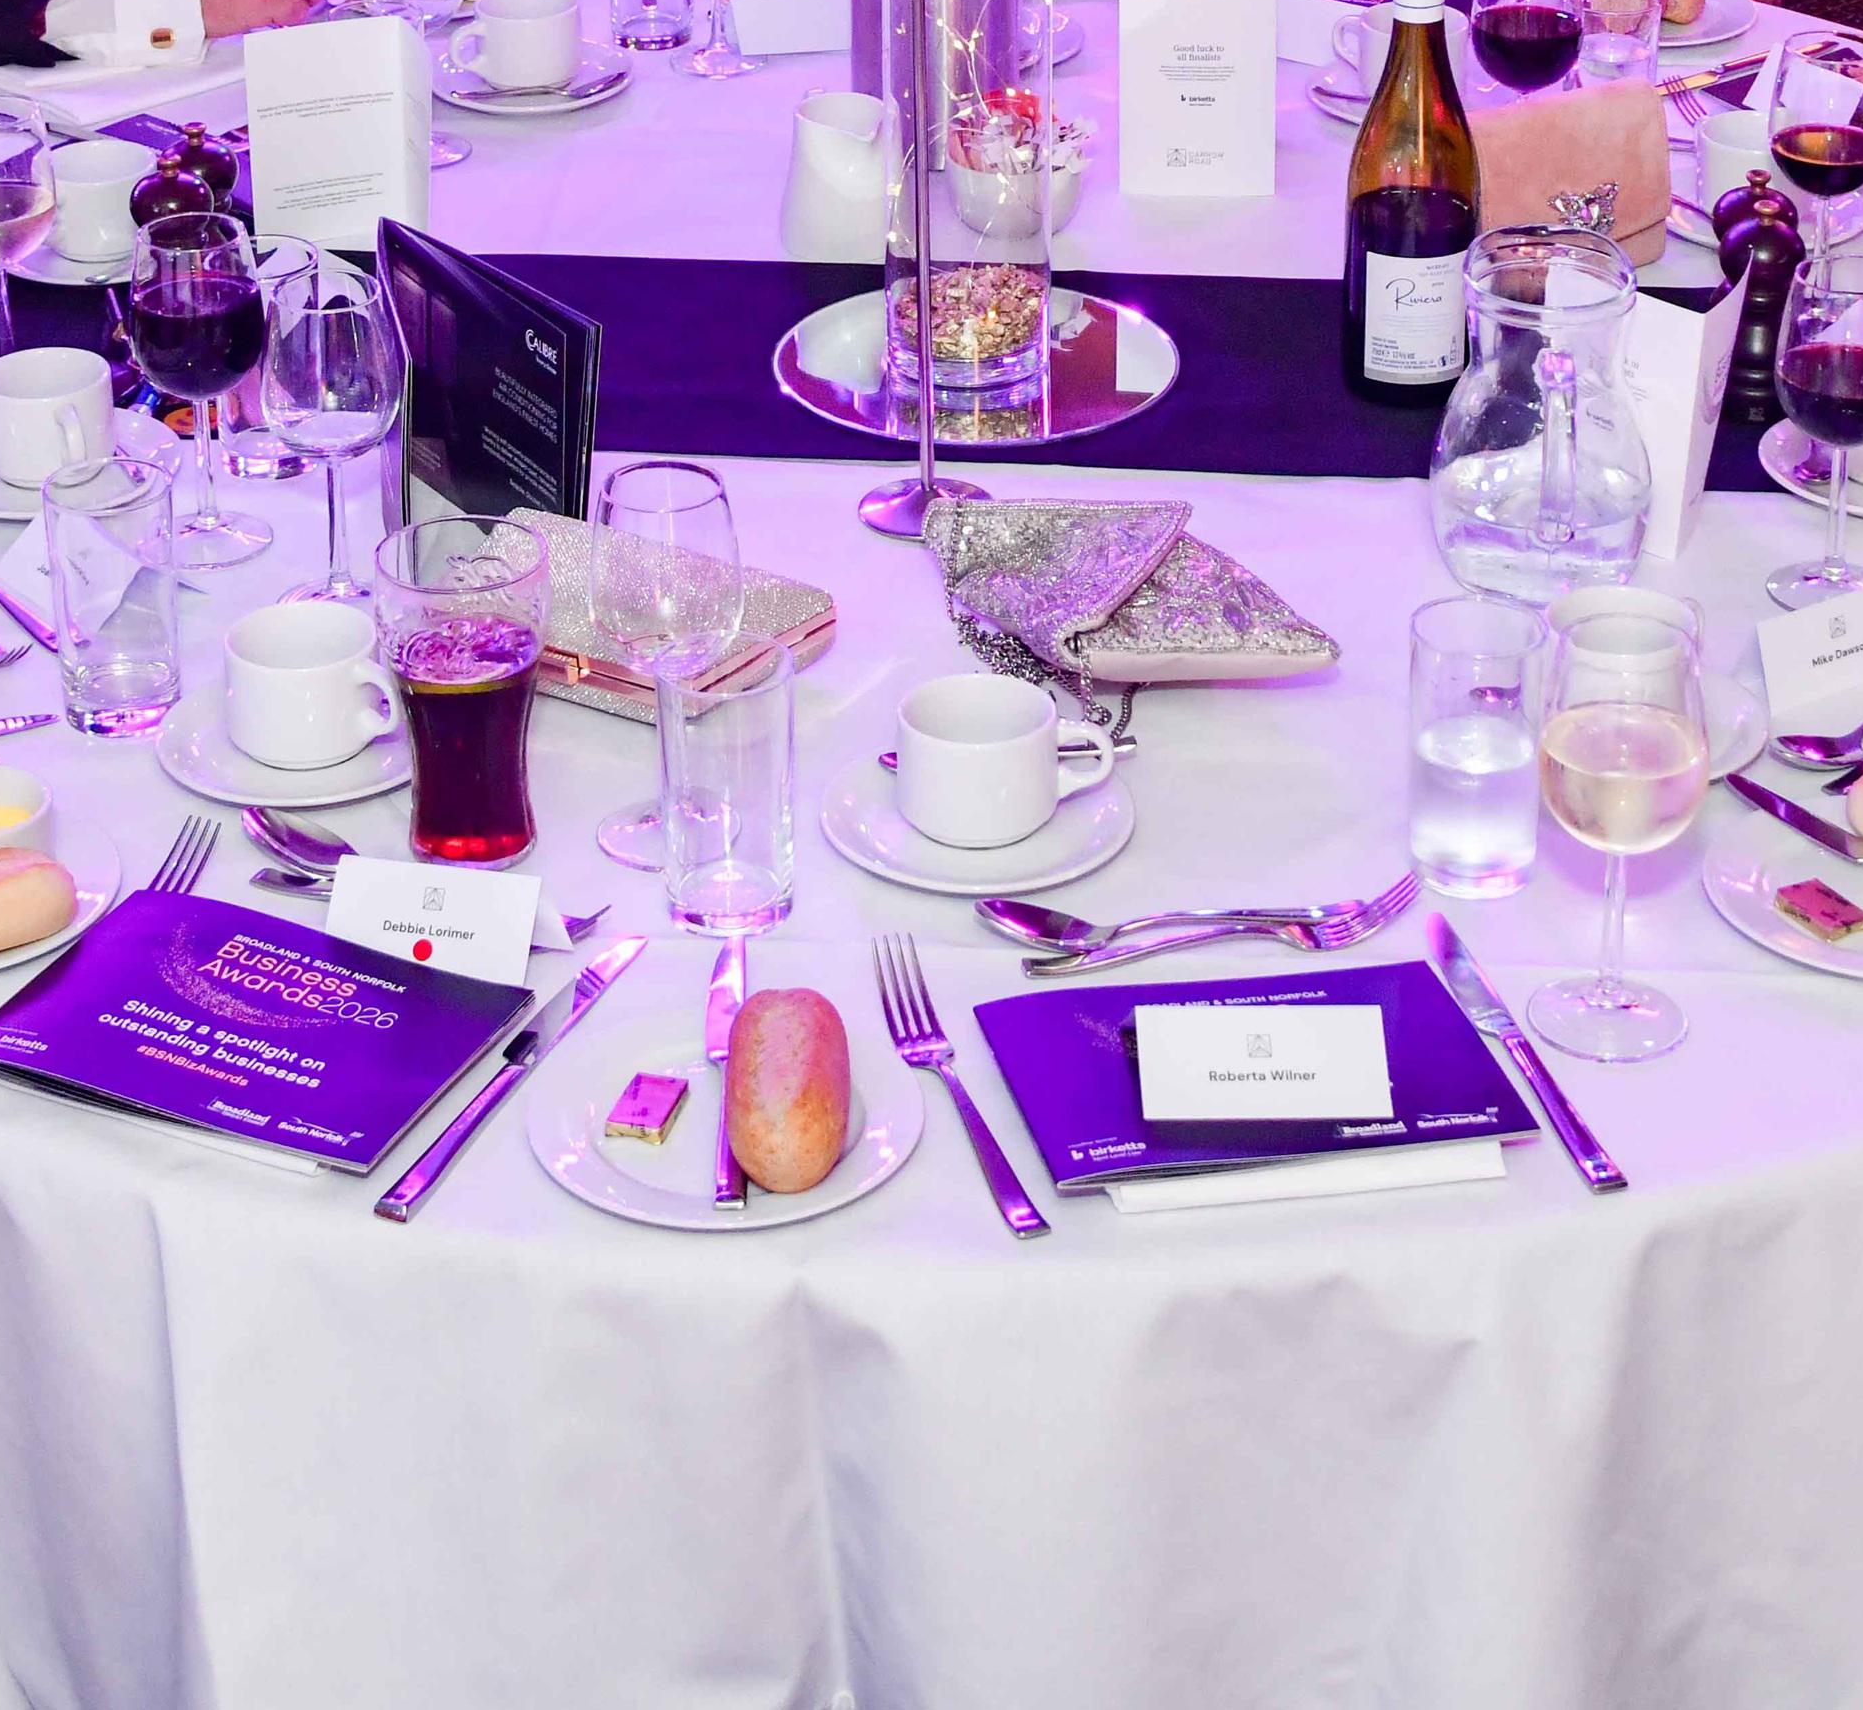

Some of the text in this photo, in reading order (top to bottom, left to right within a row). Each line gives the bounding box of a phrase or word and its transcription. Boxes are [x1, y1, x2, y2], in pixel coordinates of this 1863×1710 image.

[1173, 44, 1195, 52] Good
[1197, 44, 1215, 52] luck
[1177, 53, 1221, 61] all finalists
[1385, 277, 1443, 311] Riviera
[525, 329, 558, 365] CALIBRE
[1812, 655, 1834, 668] Mike
[383, 919, 476, 940] Debbie Lorimer
[216, 940, 358, 998] Business
[233, 934, 301, 961] BROADLAND
[313, 958, 350, 977] SOUTH
[350, 970, 407, 994] NORFOLK
[197, 958, 400, 1030] Awards2026
[98, 1012, 321, 1089] outstanding businesses
[123, 999, 326, 1072] Shining a spotlight on
[136, 1044, 250, 1088] #BSNBizAwards
[1208, 1070, 1317, 1083] Roberta Wilner
